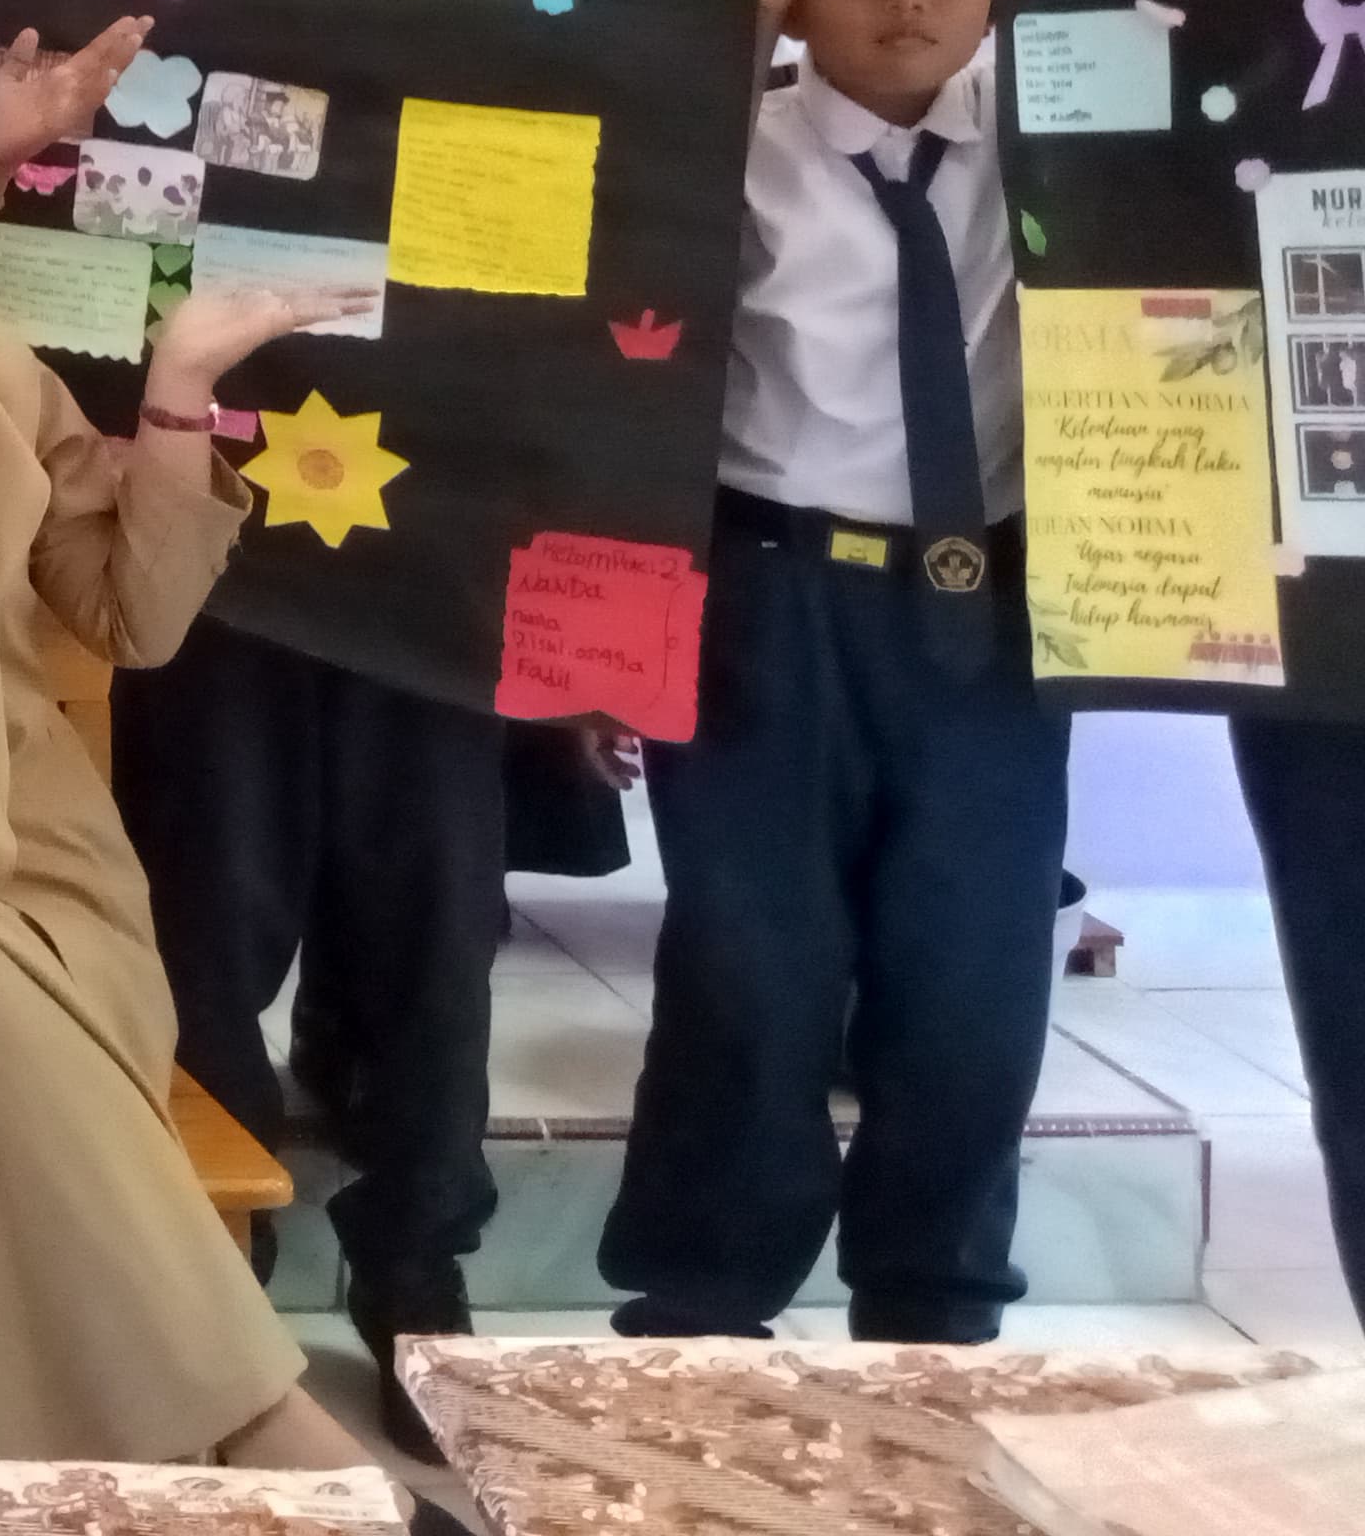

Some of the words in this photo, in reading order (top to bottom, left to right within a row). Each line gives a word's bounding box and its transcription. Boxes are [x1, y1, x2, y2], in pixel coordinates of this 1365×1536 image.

[1026, 322, 1135, 353] ORMA
[1026, 390, 1149, 409] ENGERTIAN
[1159, 391, 1251, 412] NORMA
[1100, 515, 1194, 538] NORMA
[1064, 573, 1148, 597] Indonesia
